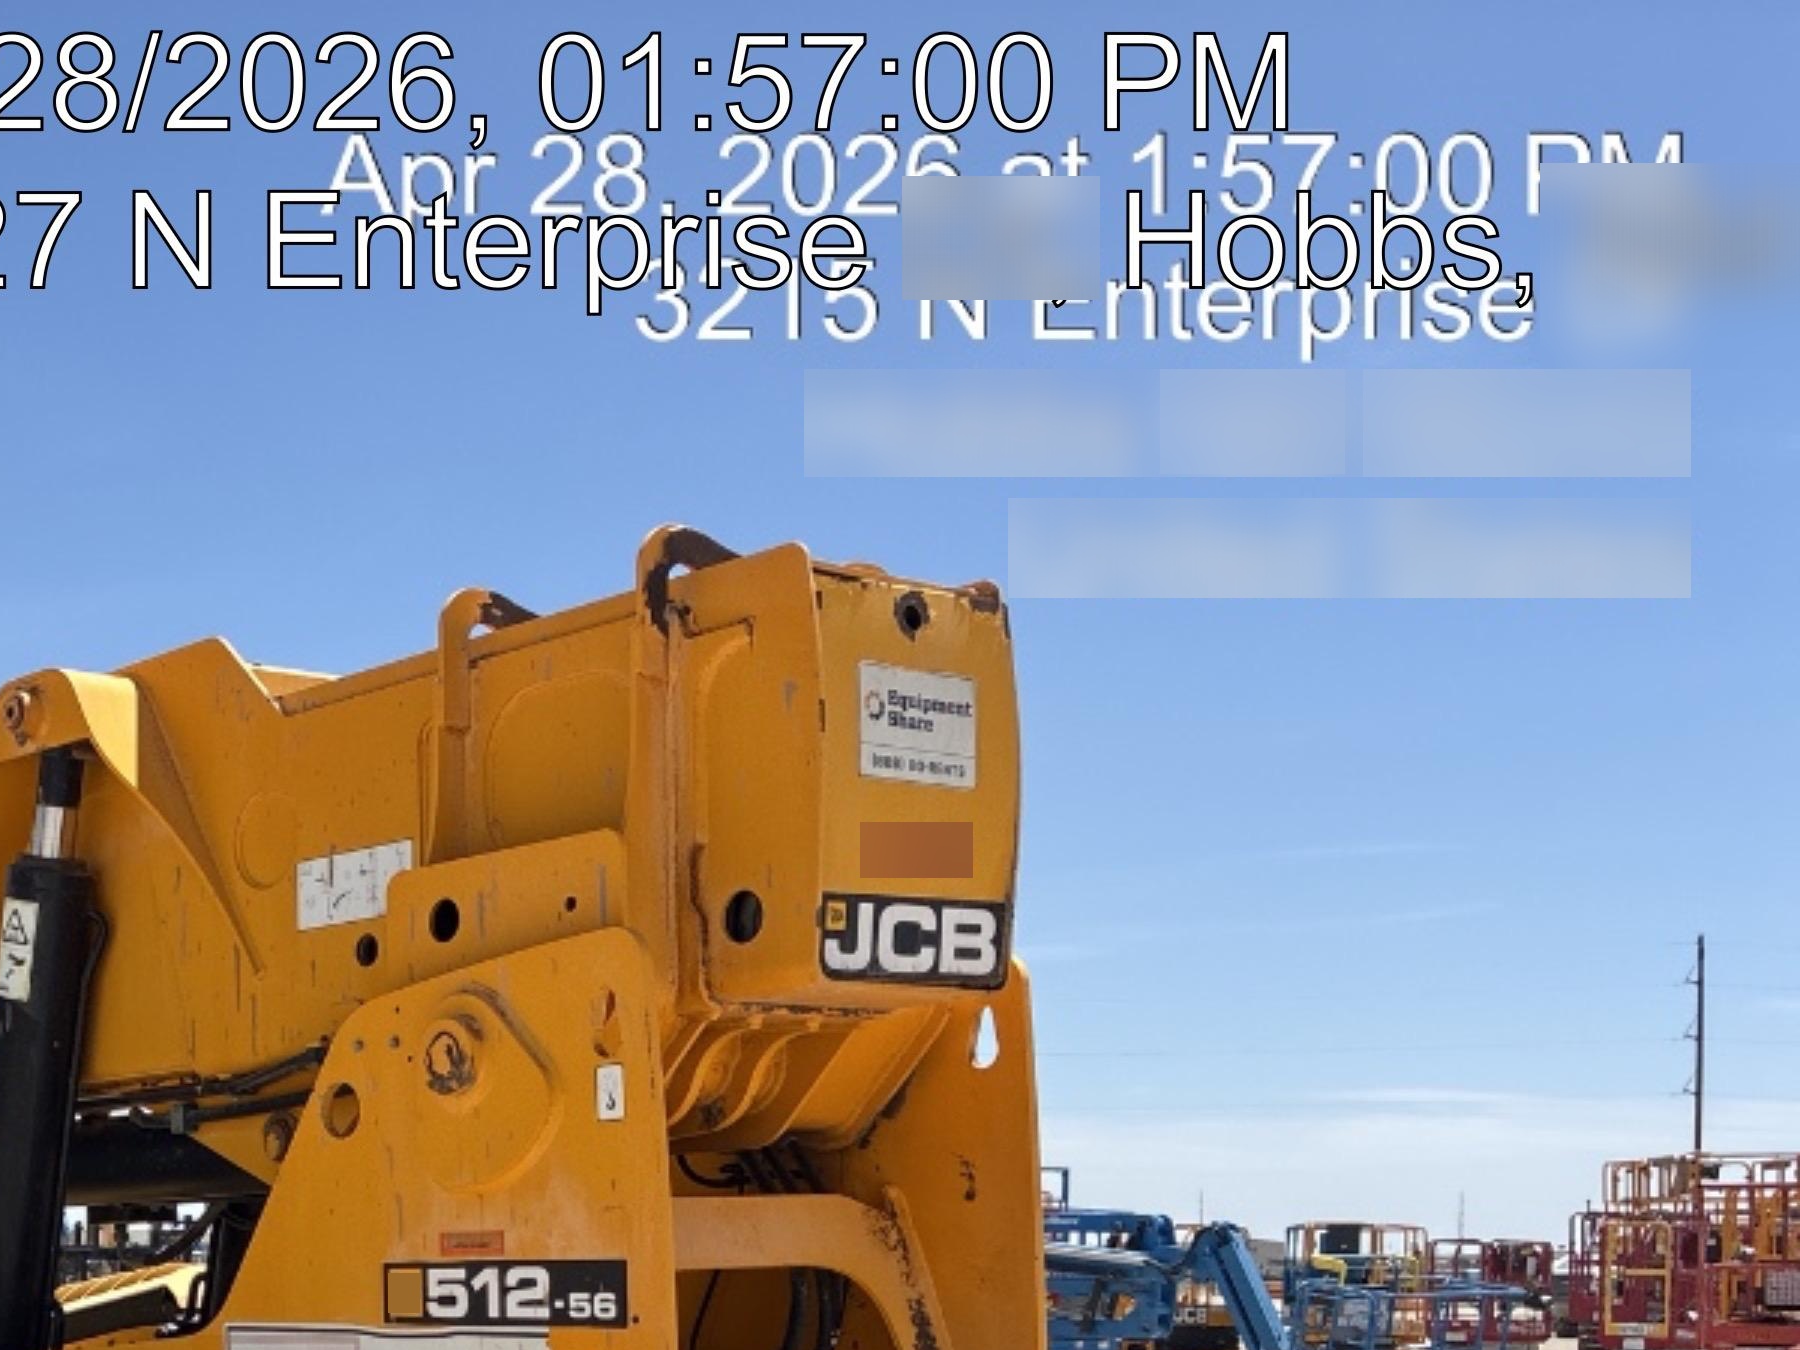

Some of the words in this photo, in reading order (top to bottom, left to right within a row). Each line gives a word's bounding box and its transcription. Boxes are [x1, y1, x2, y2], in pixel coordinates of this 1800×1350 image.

[887, 689, 973, 717] Equipment
[887, 710, 934, 732] Share
[823, 902, 998, 976] JCB
